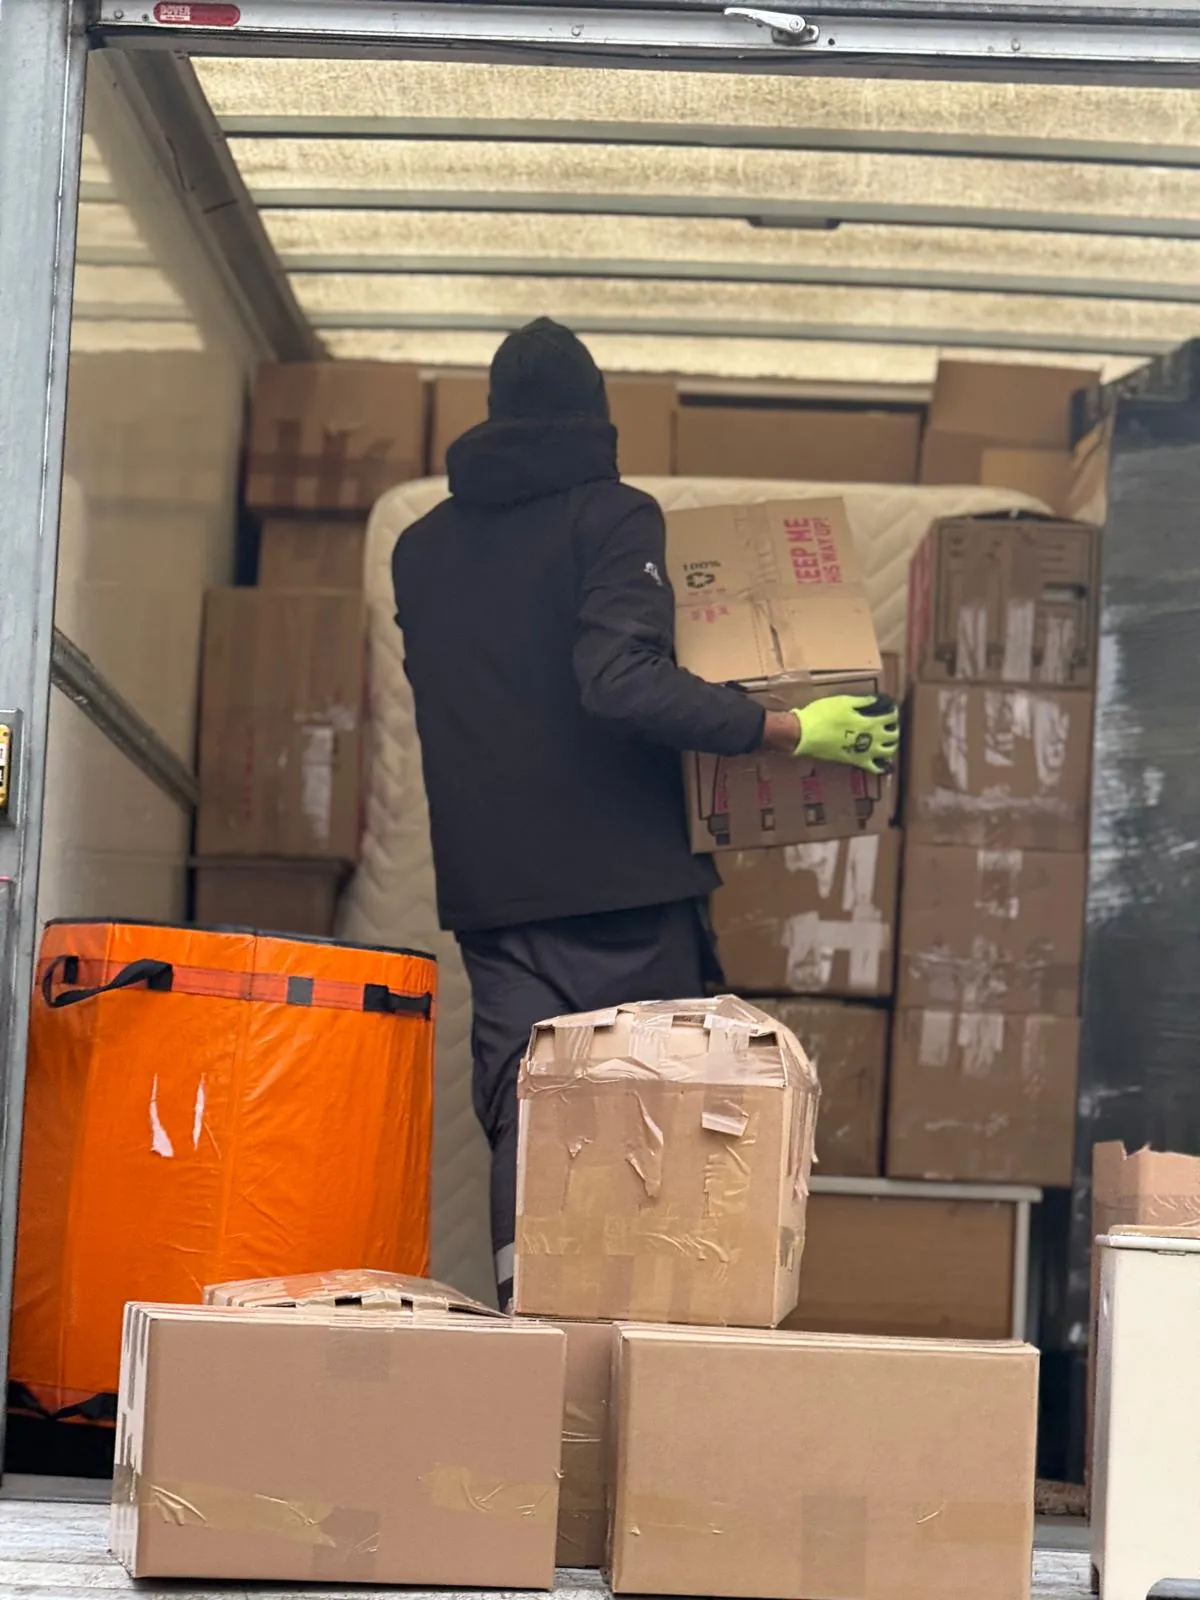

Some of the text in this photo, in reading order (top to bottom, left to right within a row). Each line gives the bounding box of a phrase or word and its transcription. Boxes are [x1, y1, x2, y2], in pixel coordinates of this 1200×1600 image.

[784, 517, 812, 542] ME
[683, 561, 722, 572] 100%
[823, 564, 842, 584] HIS
